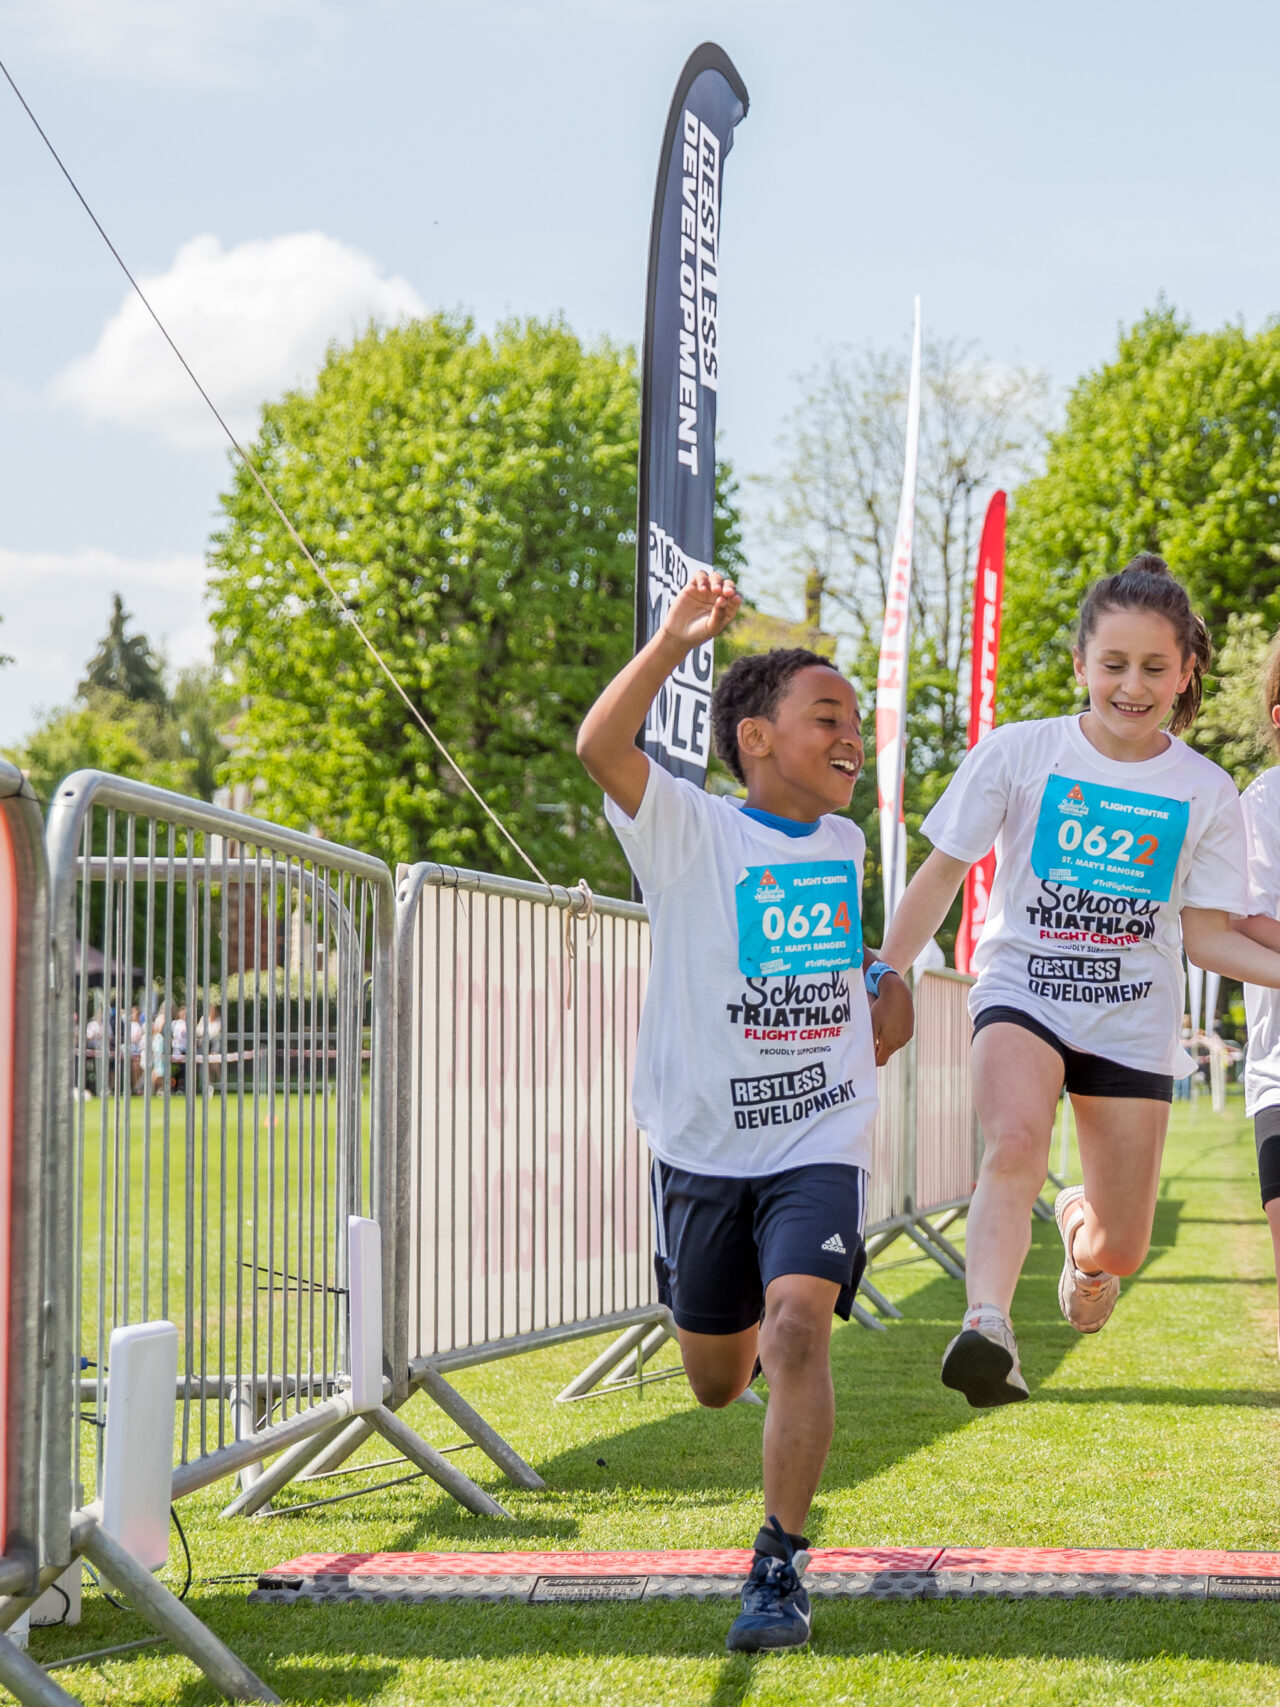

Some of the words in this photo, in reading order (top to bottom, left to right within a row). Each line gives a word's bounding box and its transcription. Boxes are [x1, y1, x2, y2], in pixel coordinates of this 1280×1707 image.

[701, 130, 718, 389] RESTLESS
[677, 109, 699, 475] DEVELOPMENT
[1100, 800, 1133, 813] FLIGHT
[1133, 807, 1169, 820] CENTRE
[1058, 819, 1159, 866] 0622
[1061, 856, 1073, 864] ST.
[1106, 864, 1145, 878] RANGERS
[793, 877, 822, 886] FLIGHT
[1092, 878, 1152, 895] #TriFlightCentre
[1037, 880, 1160, 917] Schools
[762, 901, 851, 941] 0624
[1026, 906, 1156, 940] TRIATHLON
[770, 945, 783, 954] ST.
[813, 940, 847, 951] RANGERS
[1040, 929, 1089, 941] FLIGHT
[1090, 934, 1141, 946] CENTRE
[1030, 957, 1117, 981] RESTLESS
[741, 971, 850, 1009] Schools
[1028, 979, 1153, 1004] DEVELOPMENT
[726, 1003, 851, 1027] TRIATHLON
[744, 1028, 798, 1041] FLIGHT
[799, 1026, 842, 1041] CENTRE
[759, 1048, 796, 1056] PROUDLY
[734, 1066, 823, 1104] RESTLESS
[734, 1079, 857, 1130] DEVELOPMENT
[821, 1243, 847, 1254] adidas
